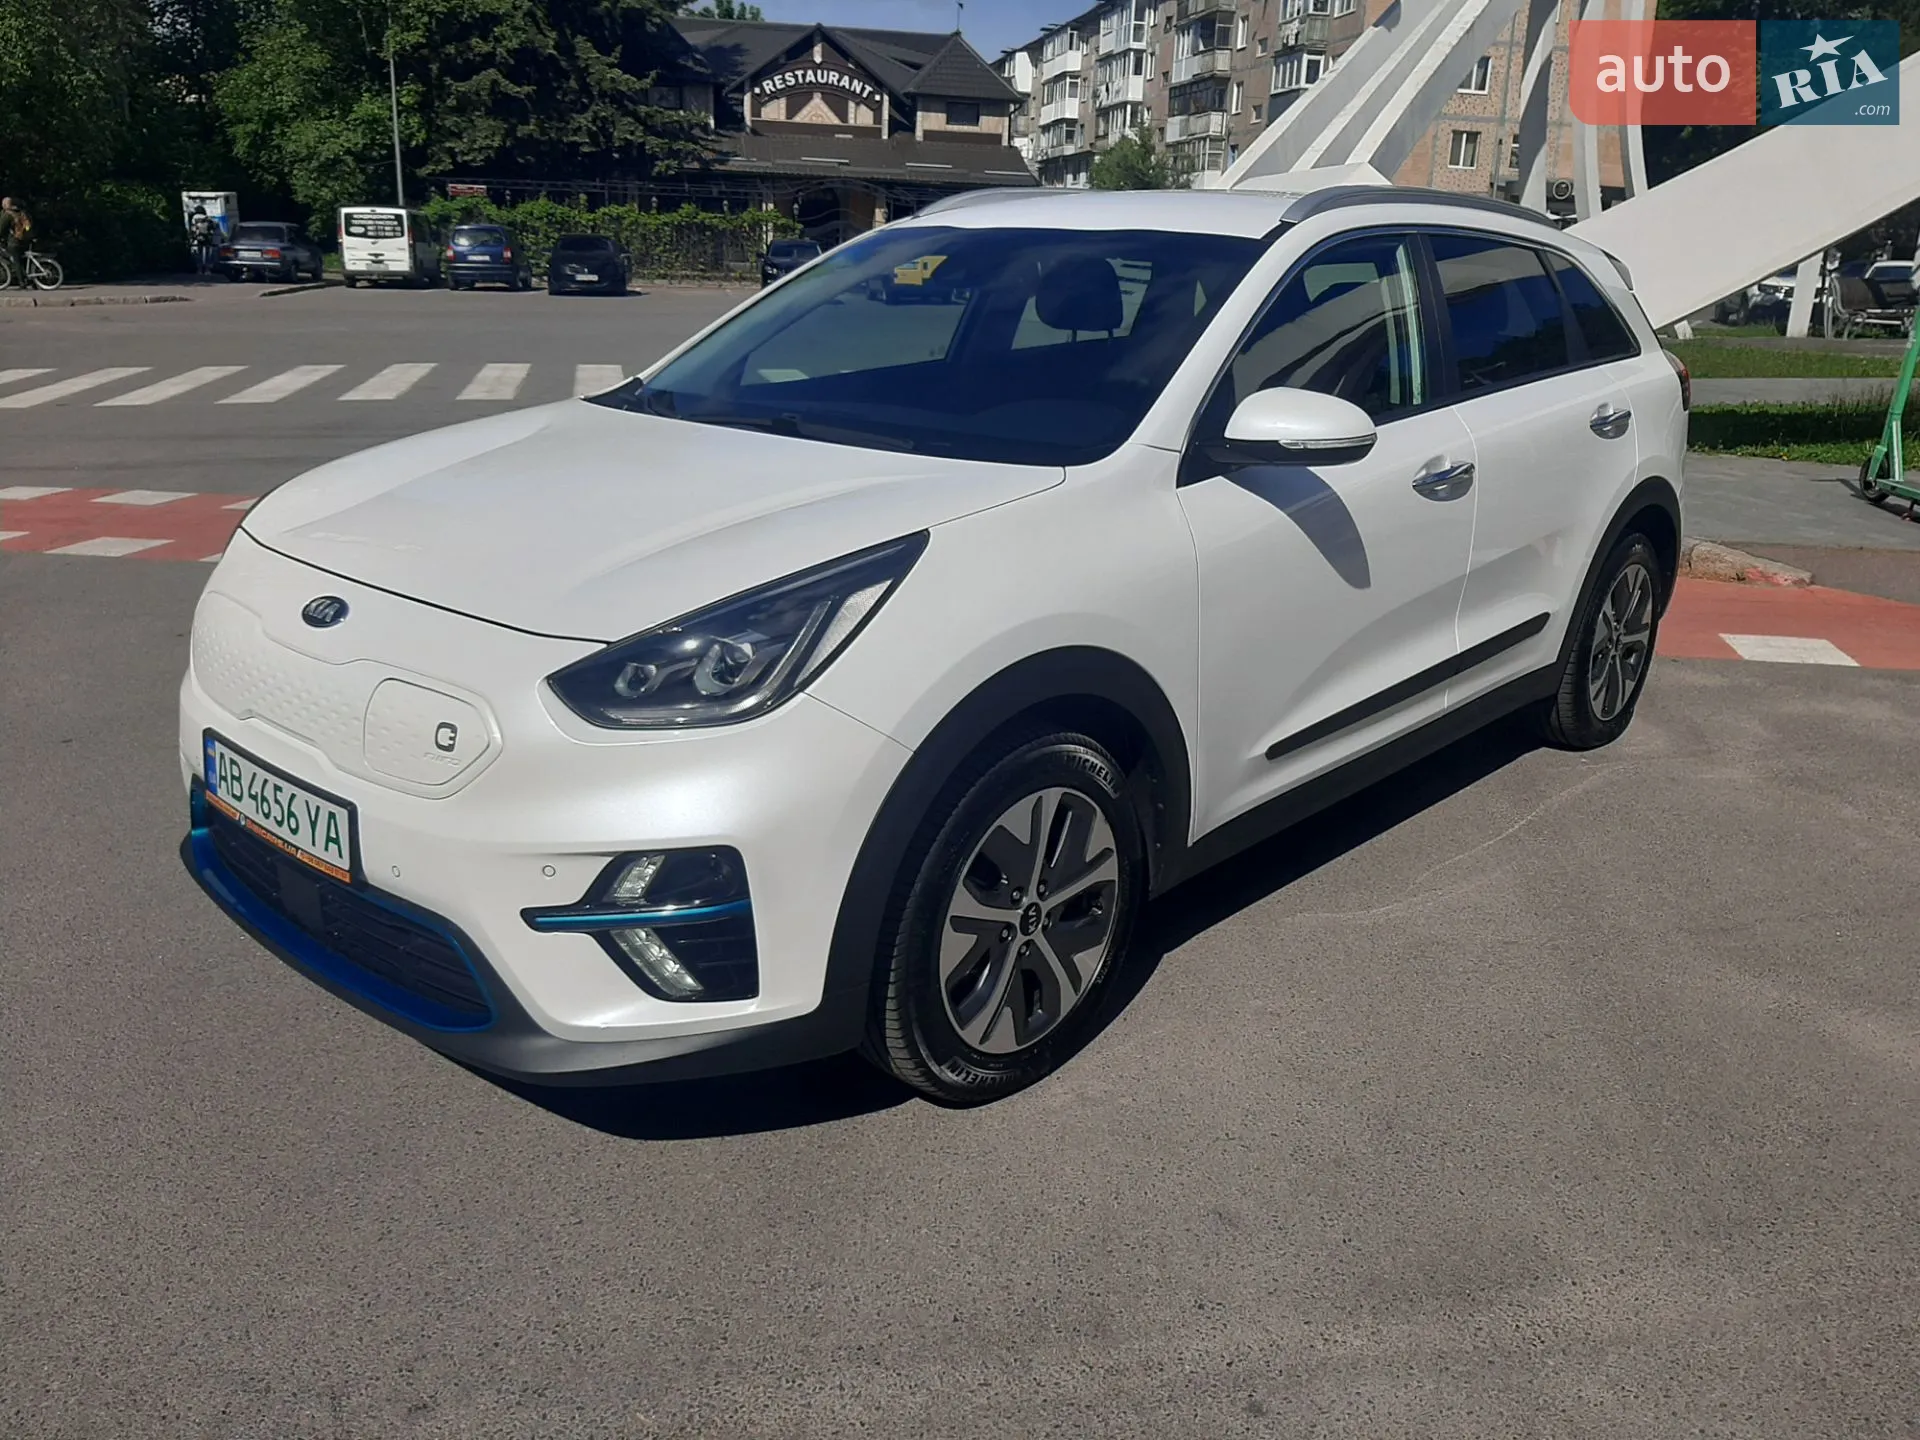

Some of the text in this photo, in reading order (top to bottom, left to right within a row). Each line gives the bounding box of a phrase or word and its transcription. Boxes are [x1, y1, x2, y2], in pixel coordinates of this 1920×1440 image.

[762, 69, 873, 98] RESTAURANT
[304, 598, 341, 623] KIA
[218, 752, 244, 803] AB
[247, 772, 300, 836] 4656
[305, 799, 344, 860] YA
